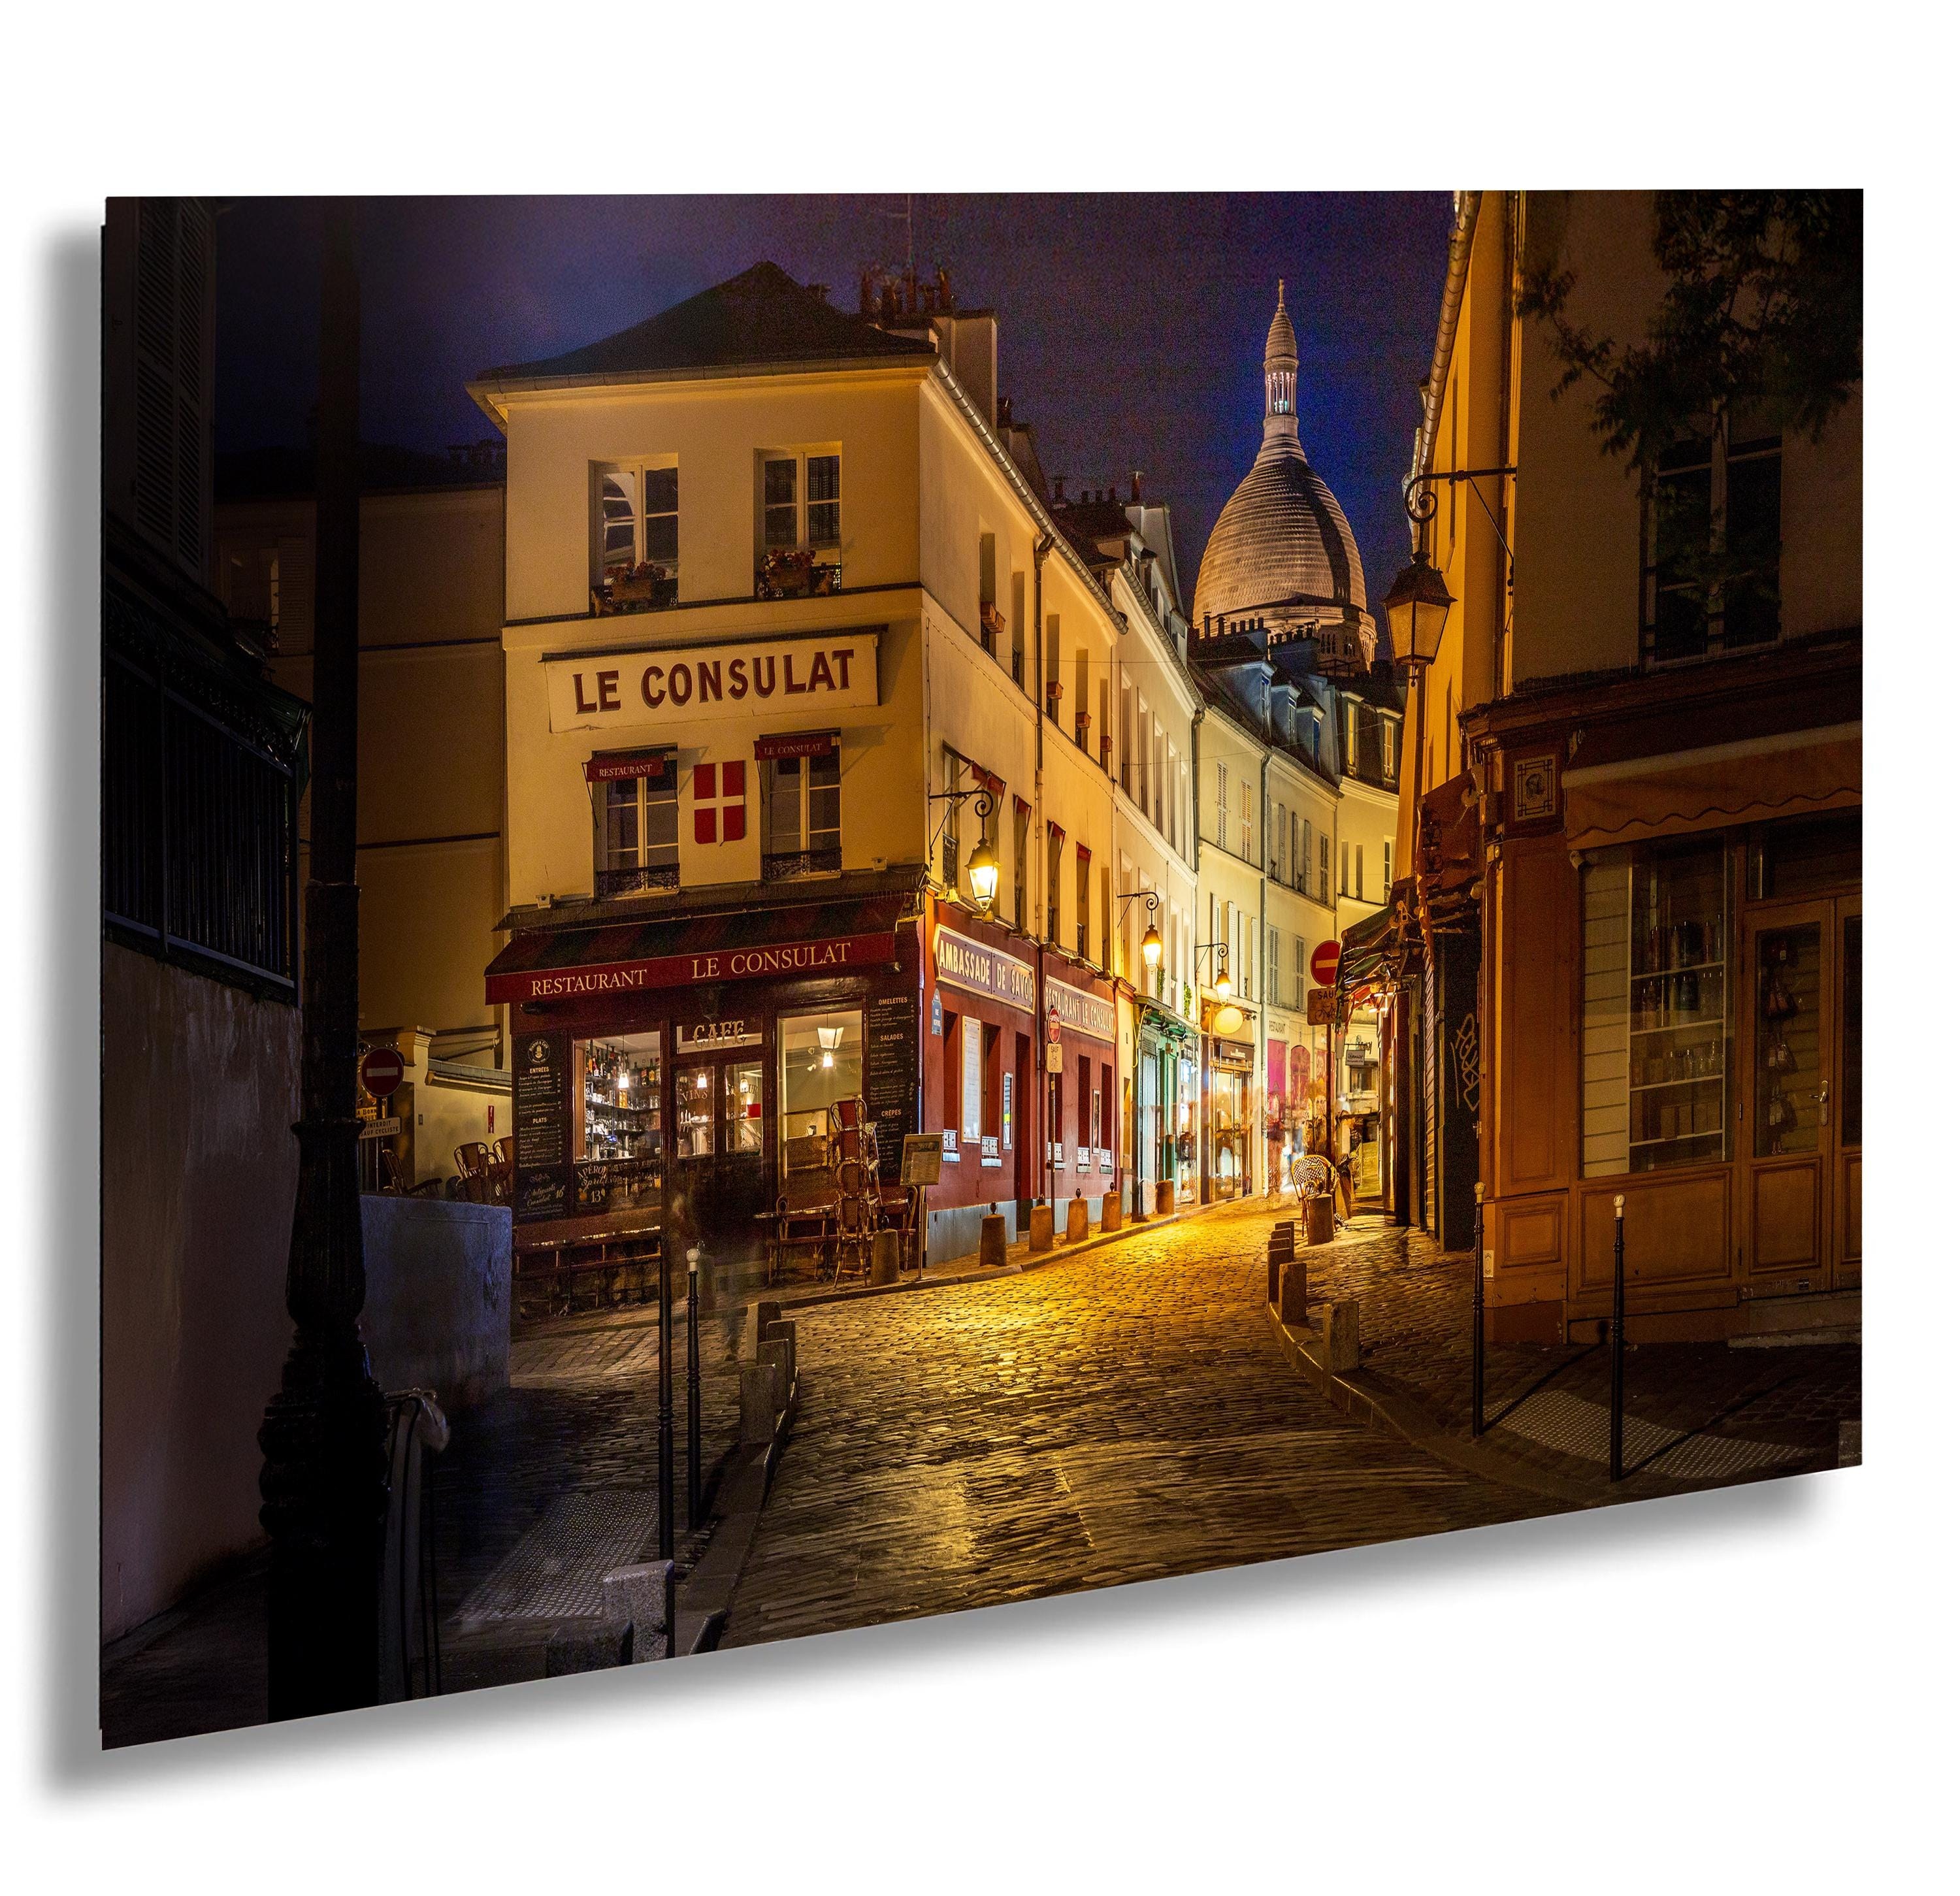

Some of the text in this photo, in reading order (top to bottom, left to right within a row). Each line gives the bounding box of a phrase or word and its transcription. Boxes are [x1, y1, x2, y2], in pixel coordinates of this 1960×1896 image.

[572, 649, 855, 715] LE CONSULAT
[764, 743, 823, 755] LE CONSULAT
[598, 763, 653, 777] RESTAURANT
[531, 942, 851, 996] RESTAURANT LE CONSULAT
[939, 940, 1033, 1003] AMBASSADE DE SAVOIE
[878, 996, 908, 1005] OMELETTES
[1045, 987, 1114, 1034] RESTAURANT LE CONSULAT
[880, 1033, 904, 1041] SALADES
[681, 1089, 708, 1102] VINS
[367, 1120, 391, 1129] INTERDIT
